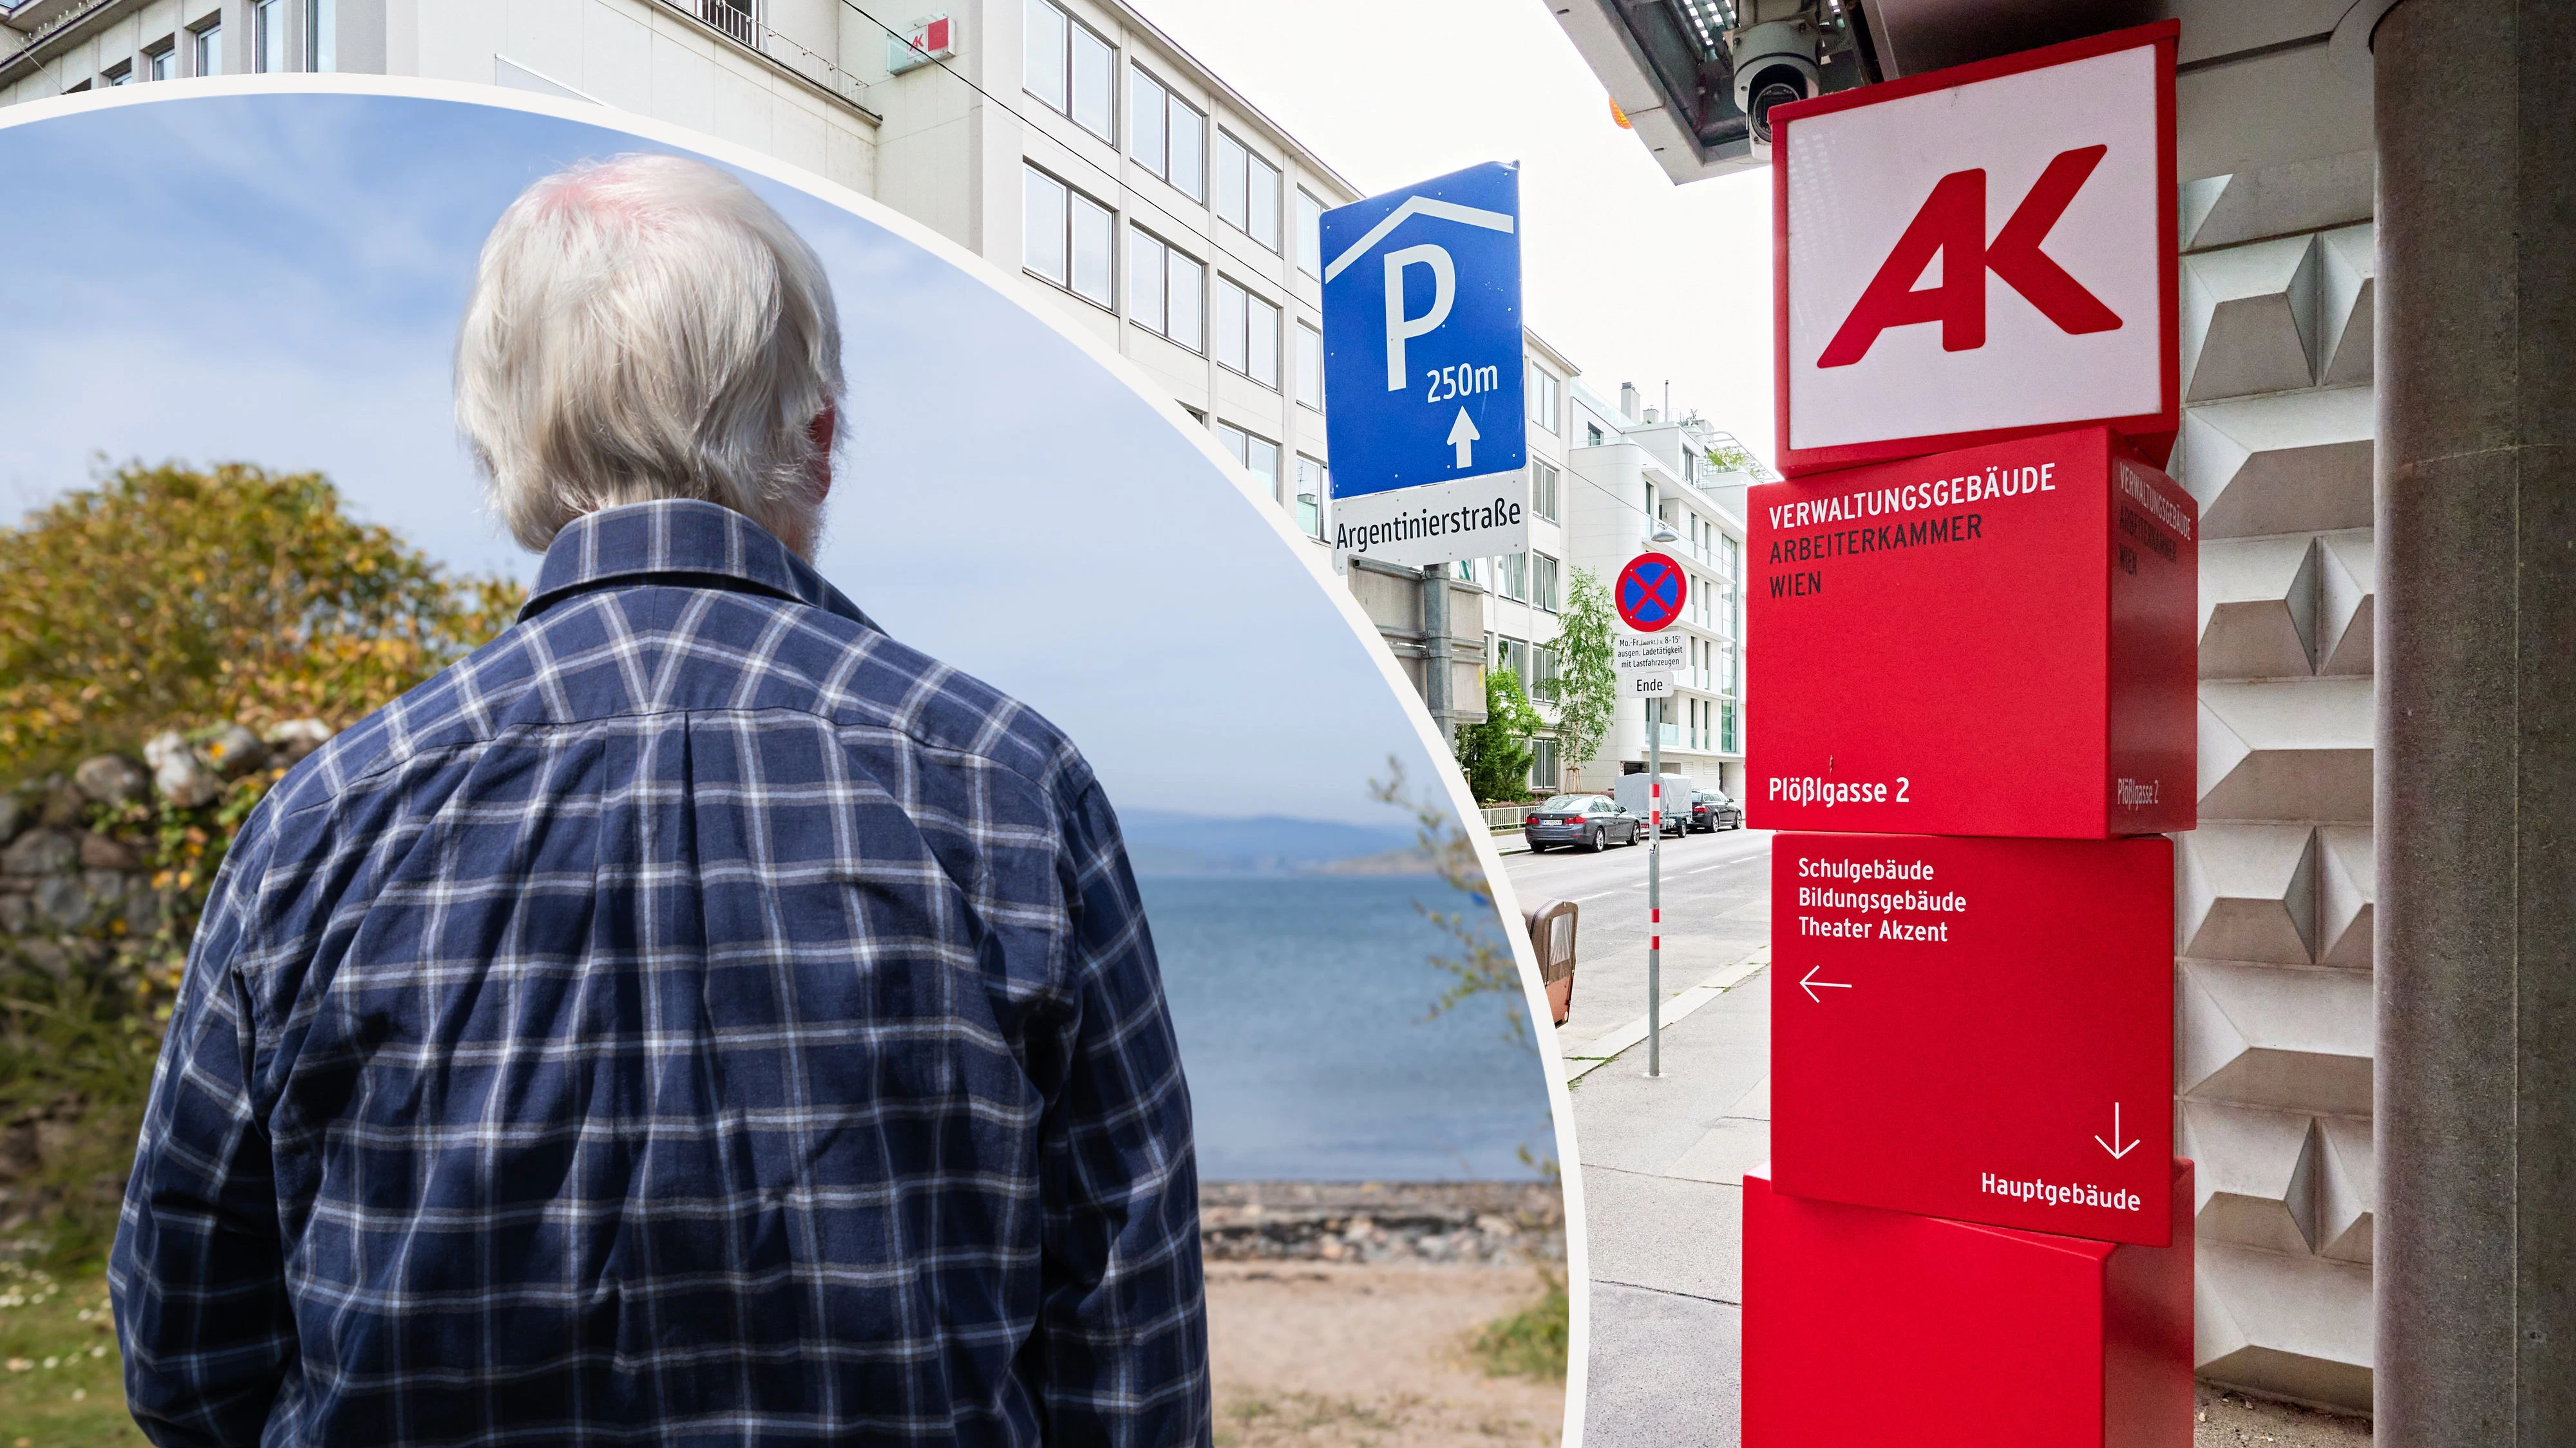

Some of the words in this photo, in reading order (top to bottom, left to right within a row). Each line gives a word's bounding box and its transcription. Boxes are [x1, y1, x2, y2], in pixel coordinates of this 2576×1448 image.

[909, 33, 925, 52] AK
[1817, 144, 2123, 369] AK
[1384, 244, 1456, 391] P
[1426, 362, 1498, 403] 250m
[1769, 462, 2056, 530] VERWALTUNGSGEBÄUDE
[2120, 462, 2191, 541] VERWALTUNGSGEBÄUDE
[1336, 498, 1521, 552] Argentinierstraße
[1769, 513, 1982, 565] ARBEITERKAMMER
[1769, 570, 1822, 599] WIEN
[1618, 650, 1641, 658] ausgen.
[1642, 646, 1683, 655] Ladetätigkeit
[1633, 659, 1680, 667] Lastfahrzeugen
[1636, 679, 1663, 691] Ende
[1768, 777, 1888, 807] Plößlgasse
[1895, 778, 1909, 803] 2
[2117, 778, 2152, 811] Plößlgasse
[2154, 779, 2159, 804] 2
[1798, 858, 1934, 883] Schulgebäude
[1799, 887, 1967, 914] Bildungsgebäude
[1799, 917, 1872, 939] Theater
[1879, 920, 1948, 942] Akzent
[1982, 1172, 2141, 1211] Hauptgebäude
